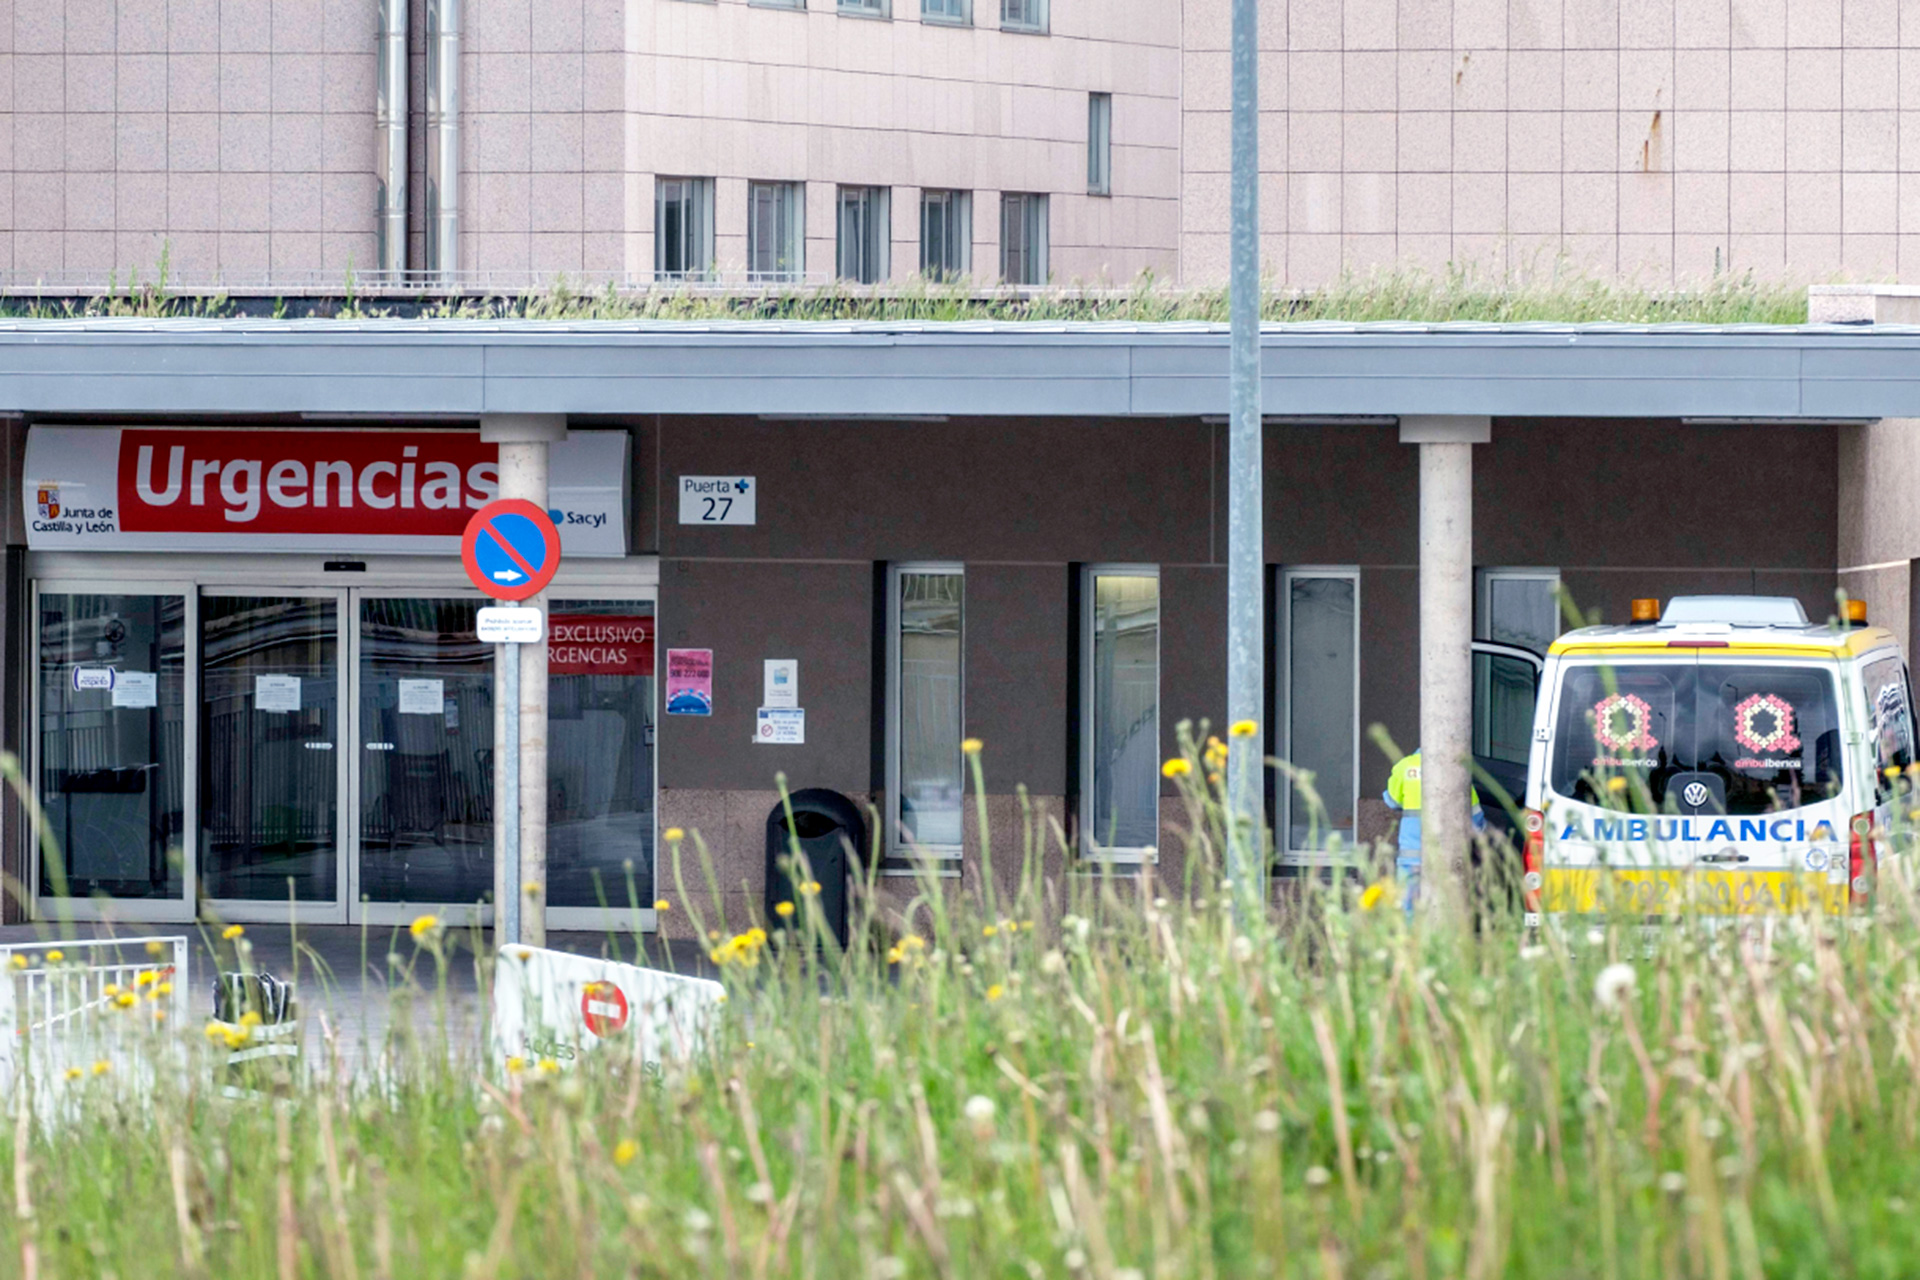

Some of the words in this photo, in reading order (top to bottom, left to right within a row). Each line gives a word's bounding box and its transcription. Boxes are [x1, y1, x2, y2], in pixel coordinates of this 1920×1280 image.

[136, 445, 499, 522] Urgencias
[684, 479, 730, 493] Puerta
[63, 506, 95, 519] Junta
[97, 507, 113, 519] de
[702, 497, 734, 521] 27
[32, 520, 73, 532] Castilla
[75, 523, 83, 535] y
[85, 520, 115, 533] León
[566, 511, 607, 528] Sacyl
[554, 625, 646, 644] EXCLUSIVO
[547, 646, 628, 665] RGENCIAS
[1560, 818, 1839, 842] AMBULANCIA
